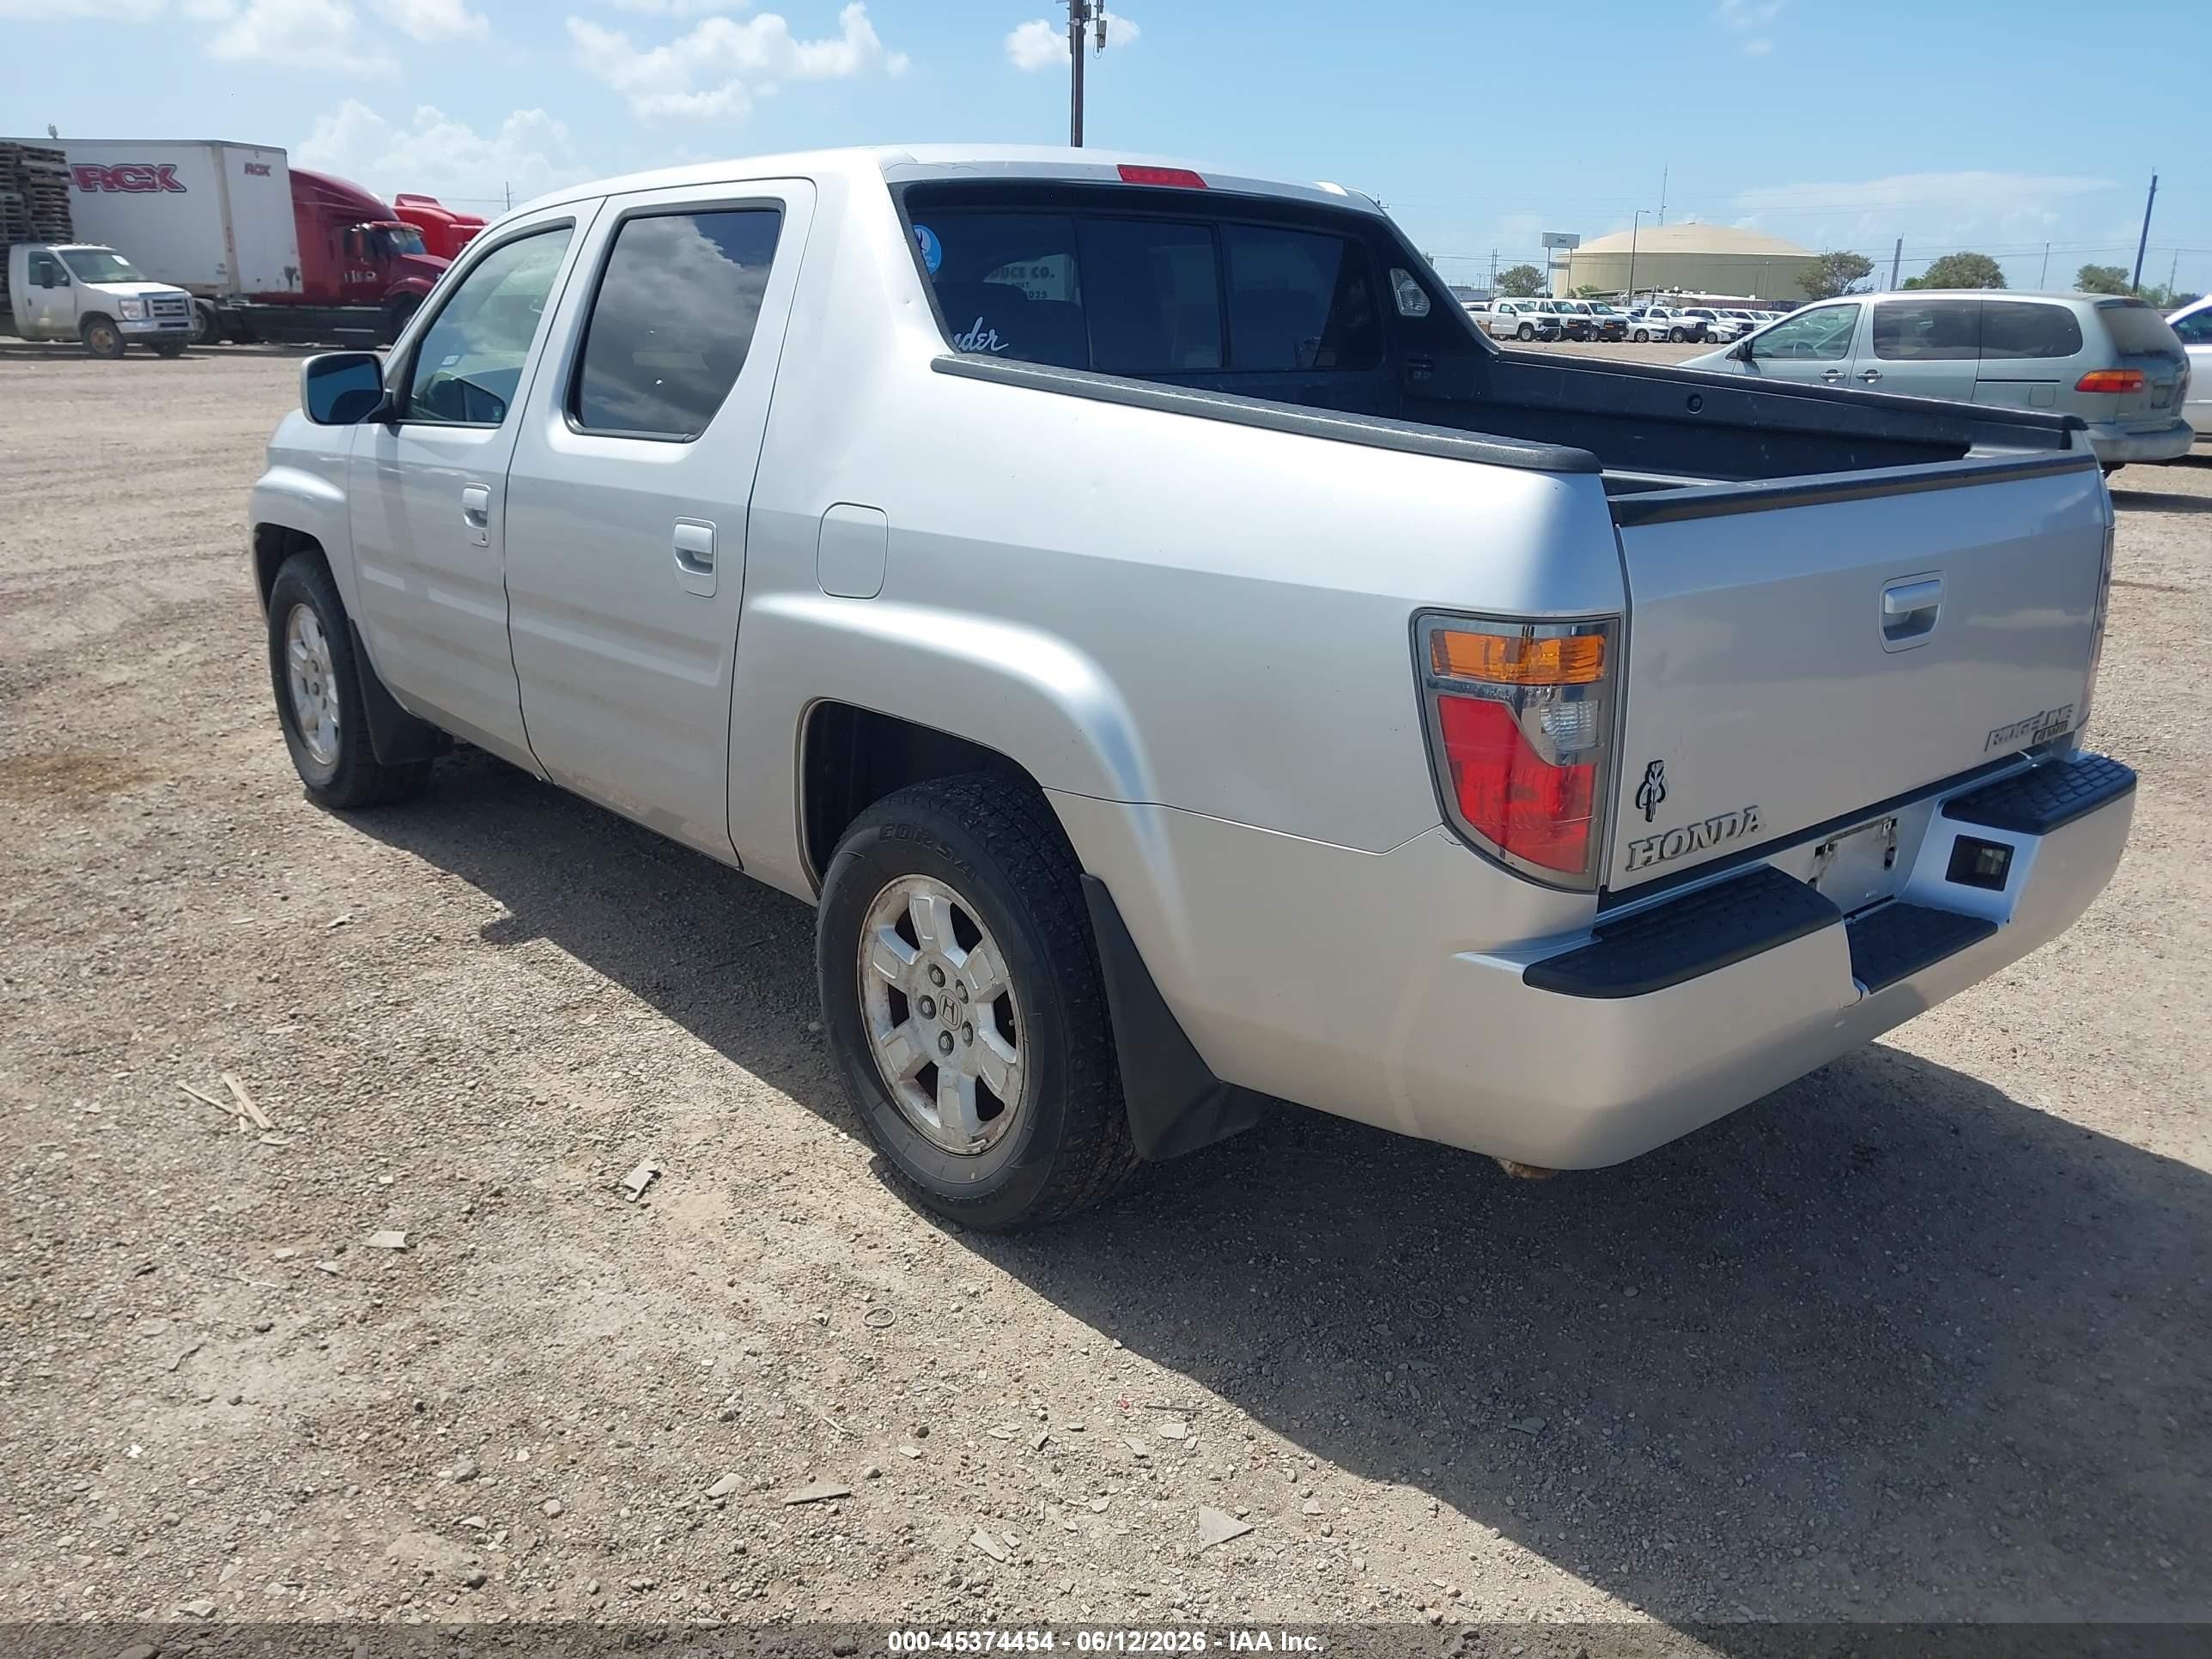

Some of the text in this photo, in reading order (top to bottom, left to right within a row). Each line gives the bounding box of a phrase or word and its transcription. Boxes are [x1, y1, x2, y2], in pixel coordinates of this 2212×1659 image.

[70, 163, 187, 192] RCX
[1030, 266, 1054, 279] CO.
[1626, 805, 1766, 872] HONDA
